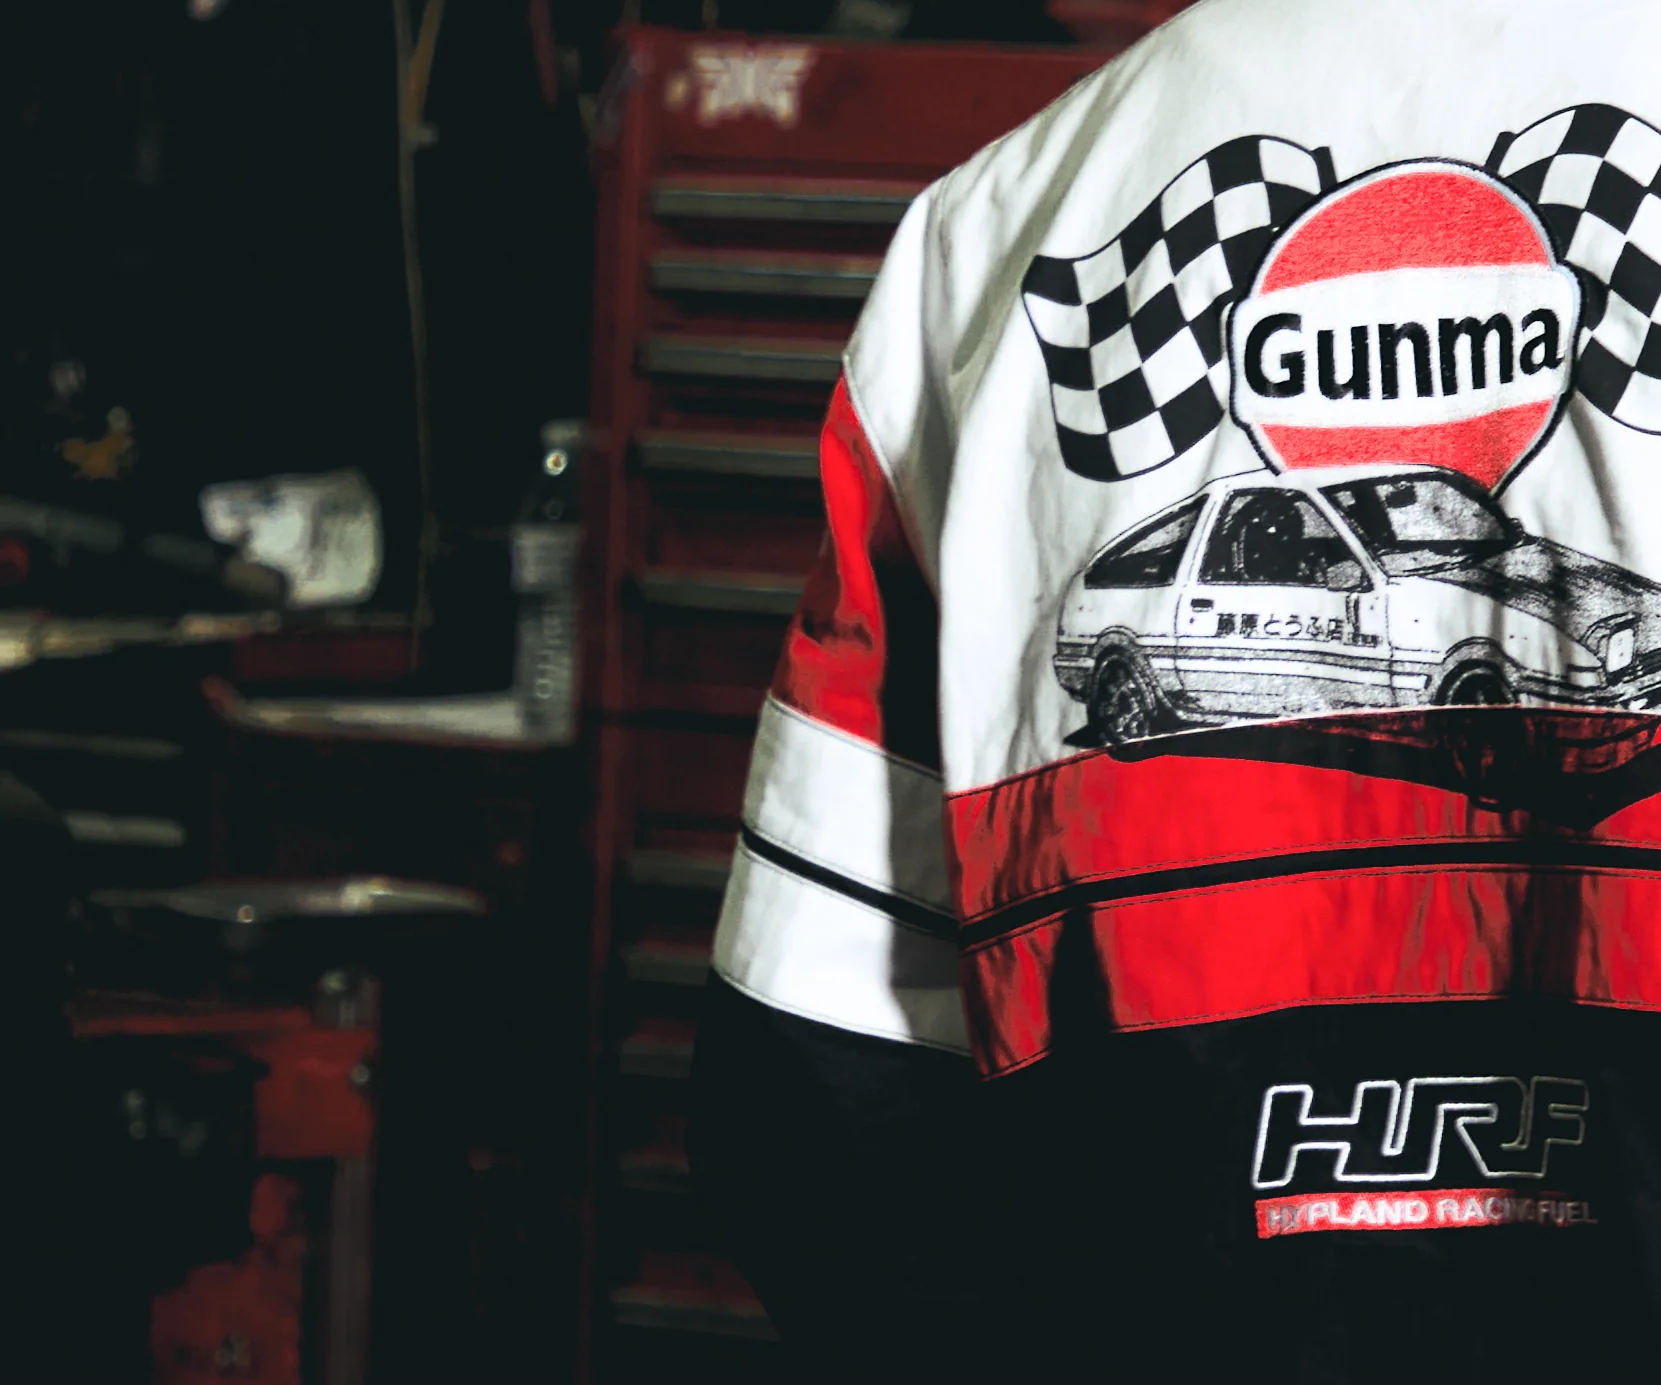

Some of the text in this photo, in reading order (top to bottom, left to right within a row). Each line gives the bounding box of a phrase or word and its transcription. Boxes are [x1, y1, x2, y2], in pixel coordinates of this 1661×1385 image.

[1244, 307, 1565, 401] Gunma
[1250, 1074, 1590, 1191] HRF
[1266, 1199, 1428, 1232] HYPLAND
[1537, 1200, 1599, 1226] FUEL
